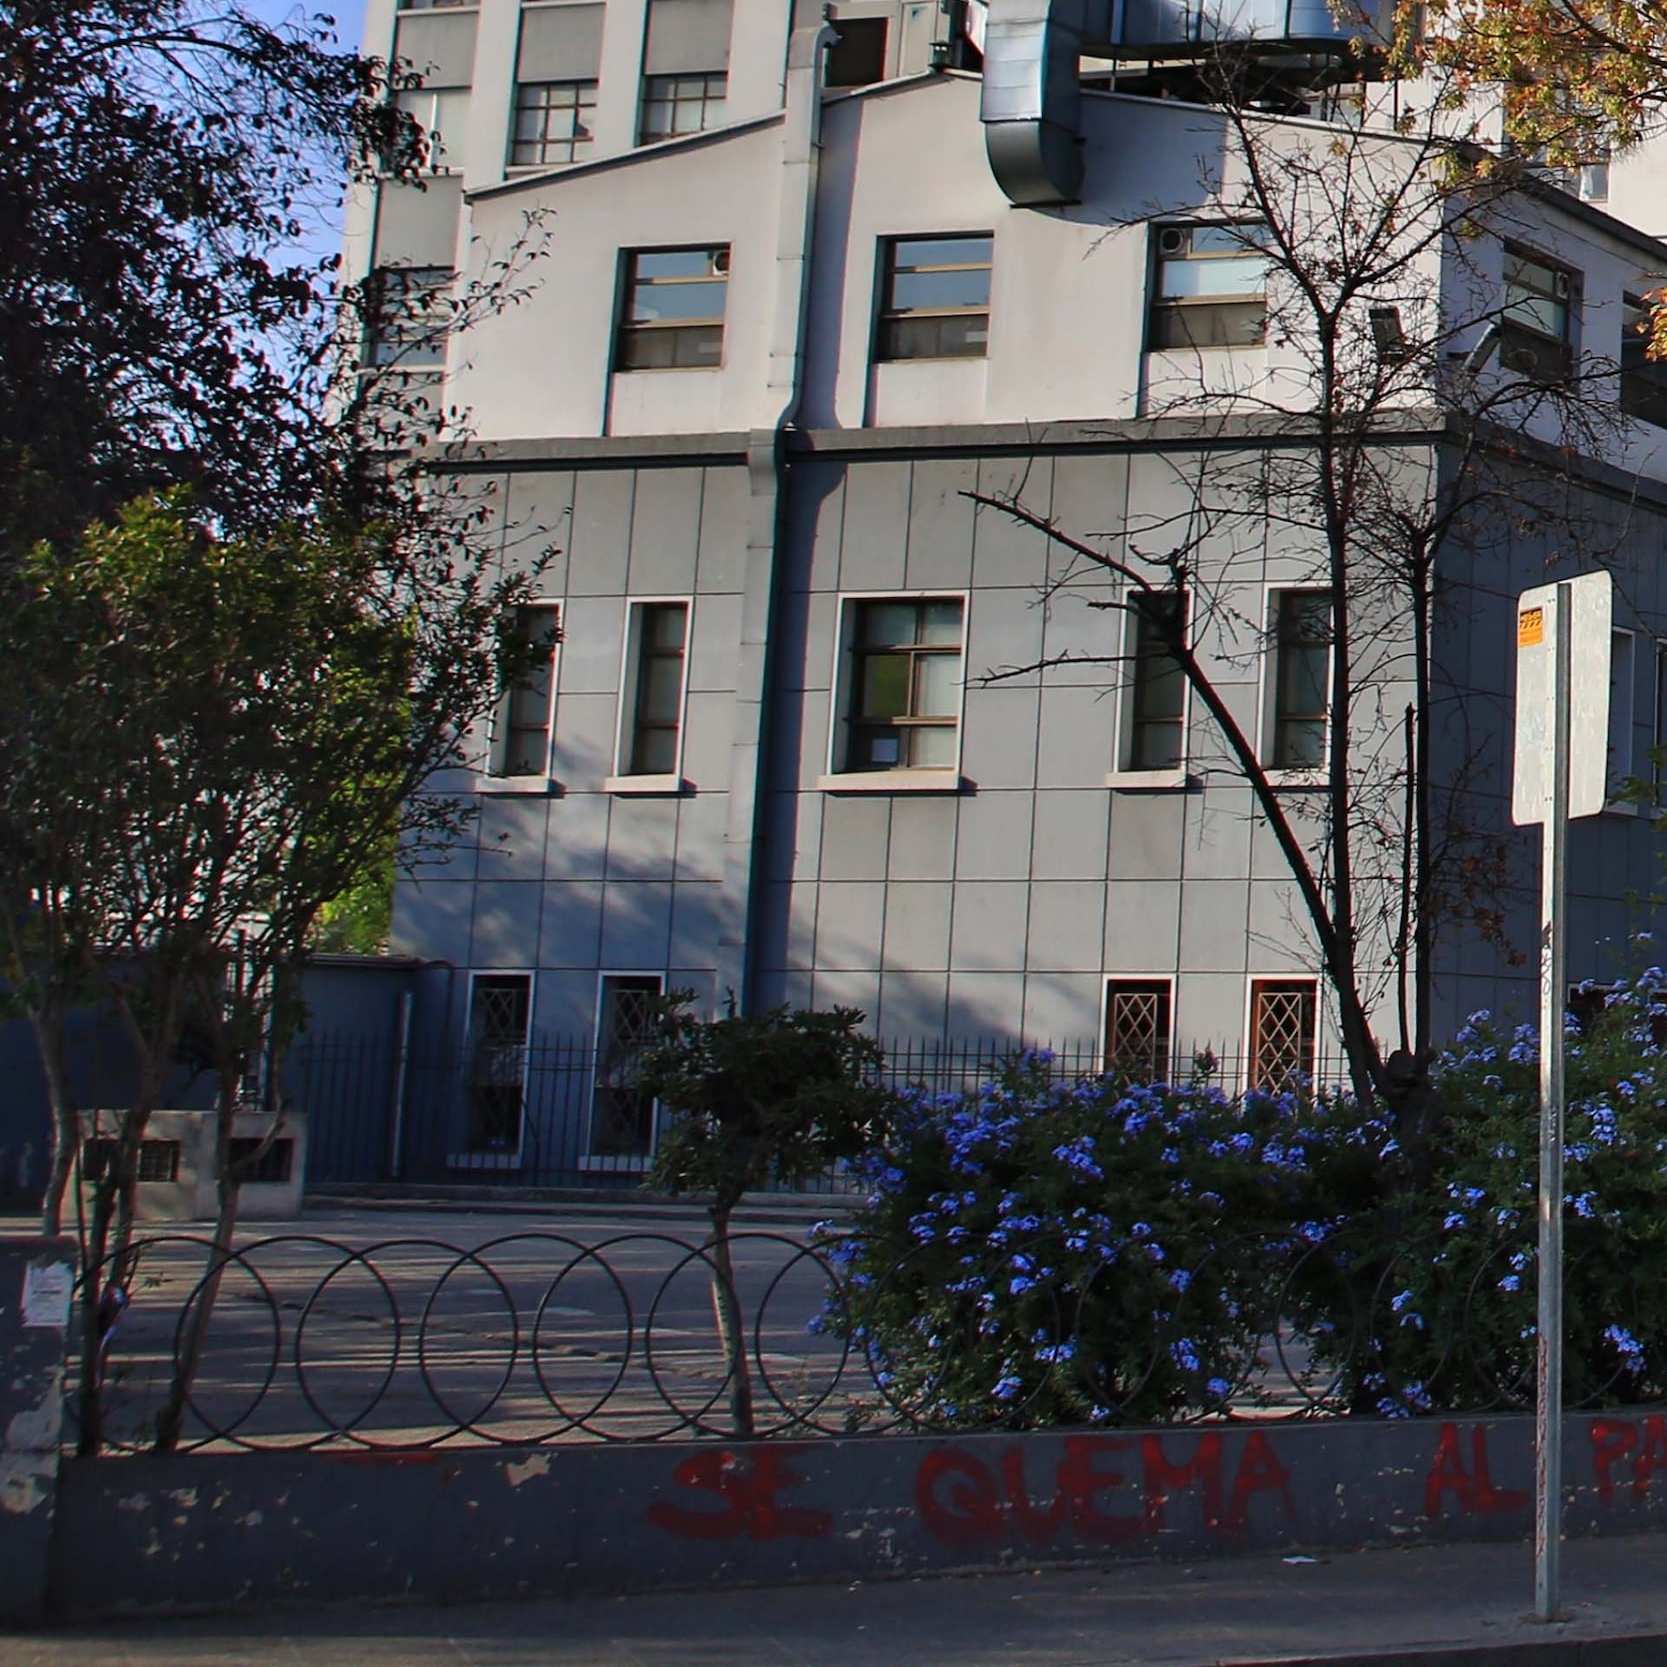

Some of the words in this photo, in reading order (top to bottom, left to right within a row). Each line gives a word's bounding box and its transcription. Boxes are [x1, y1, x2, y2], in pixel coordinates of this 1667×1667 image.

[647, 1442, 834, 1540] SE
[915, 1430, 1297, 1546] QUEMA
[1424, 1422, 1529, 1515] AL
